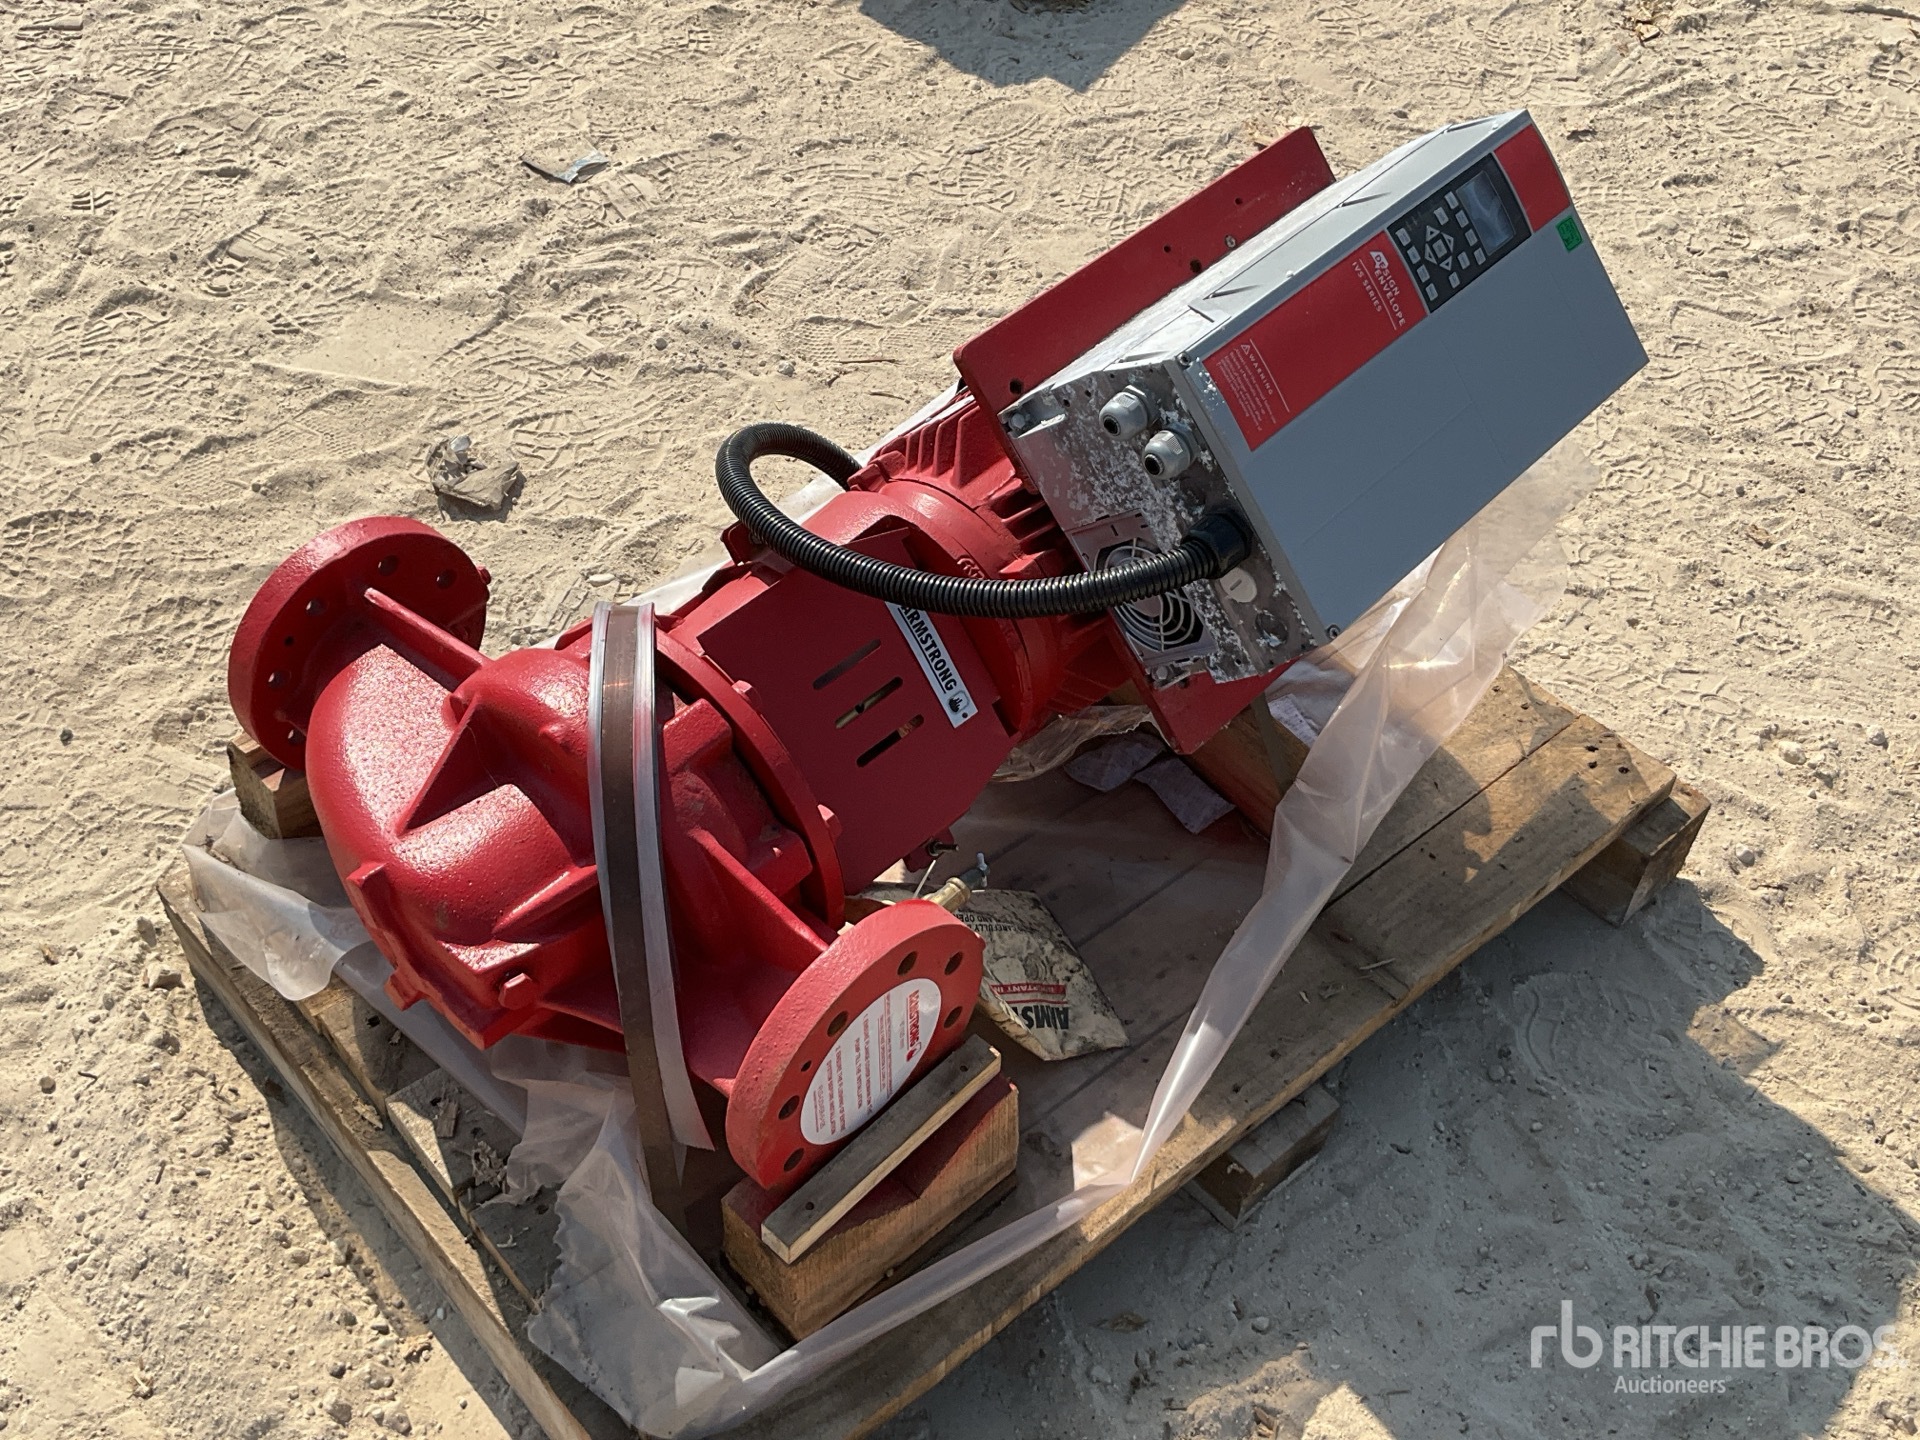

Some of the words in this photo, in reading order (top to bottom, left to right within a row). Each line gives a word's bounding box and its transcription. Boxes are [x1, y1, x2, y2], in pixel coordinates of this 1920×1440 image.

[1351, 261, 1364, 278] IVS
[1362, 279, 1382, 312] SERIES
[1374, 254, 1400, 295] DESIGN
[1374, 269, 1406, 326] ENVELOPE
[1247, 353, 1274, 395] WARNING
